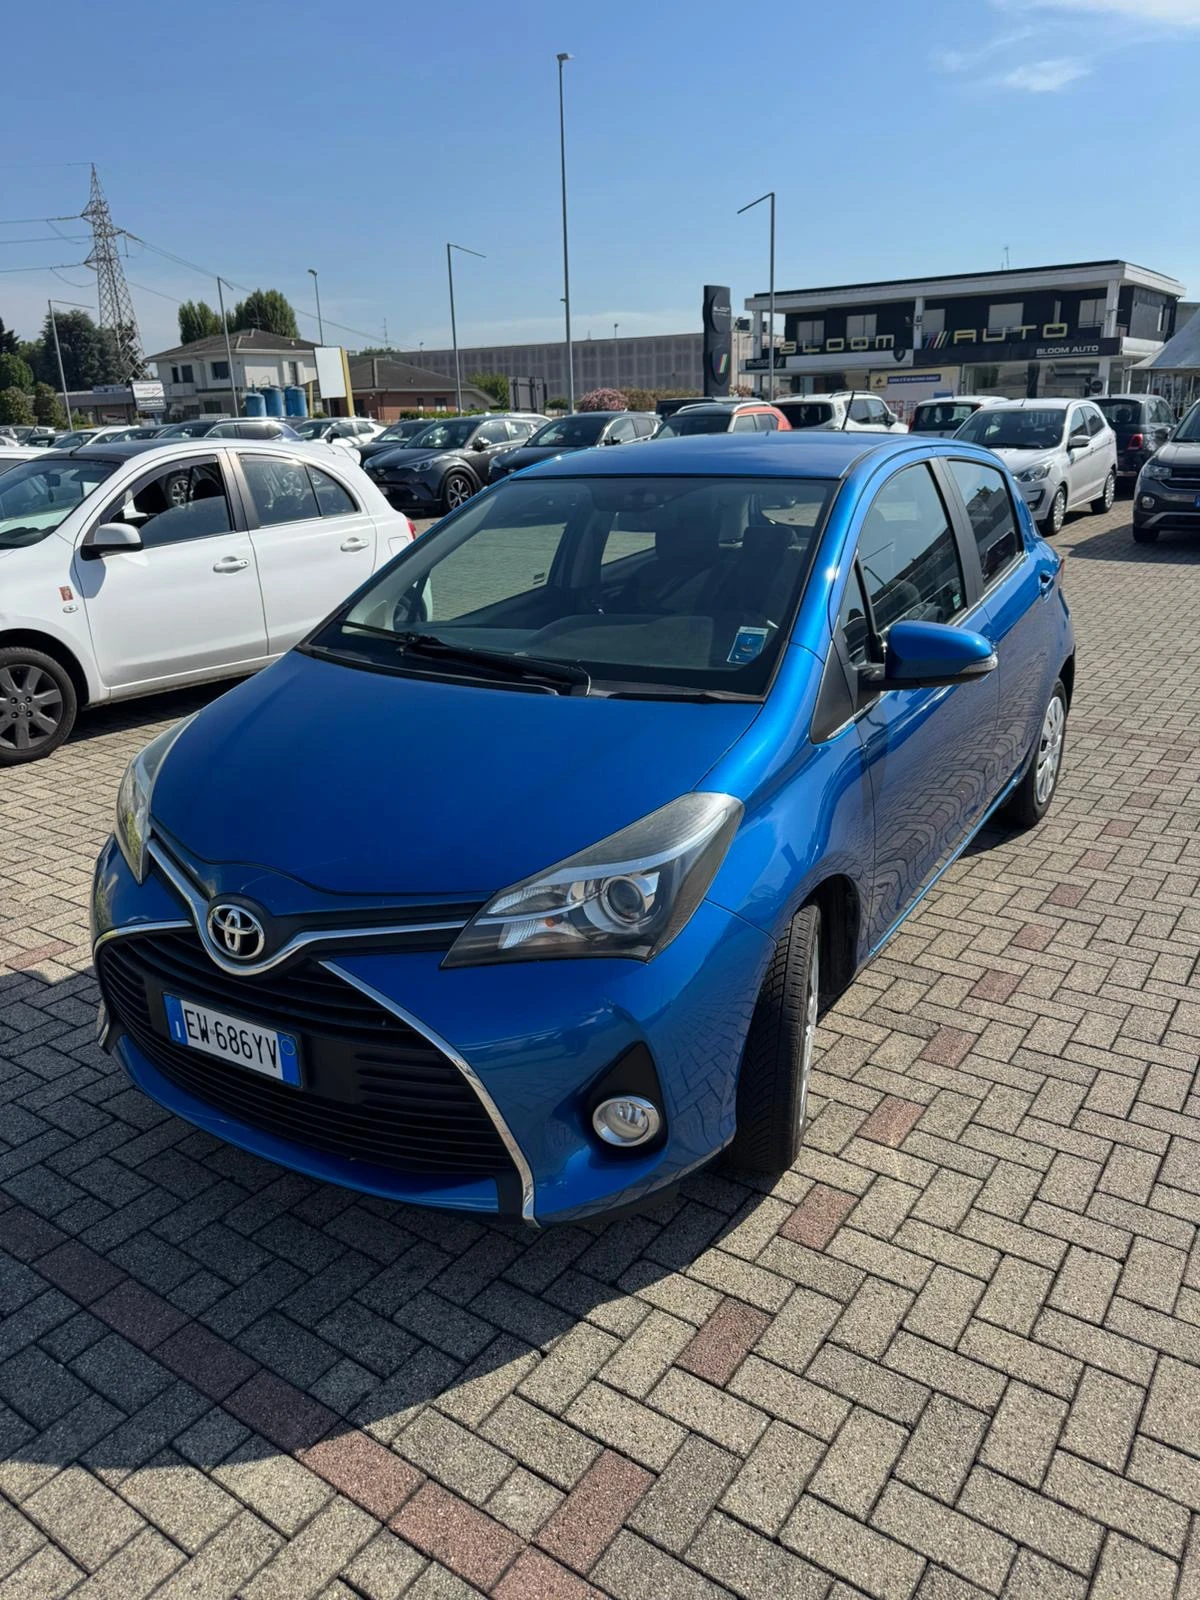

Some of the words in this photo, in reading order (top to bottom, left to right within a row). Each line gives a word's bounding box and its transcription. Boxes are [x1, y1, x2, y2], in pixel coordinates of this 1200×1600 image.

[779, 334, 895, 355] BLOOM
[953, 323, 1068, 345] AUTO
[1036, 346, 1069, 355] BLOOM
[1071, 345, 1099, 353] AUTO
